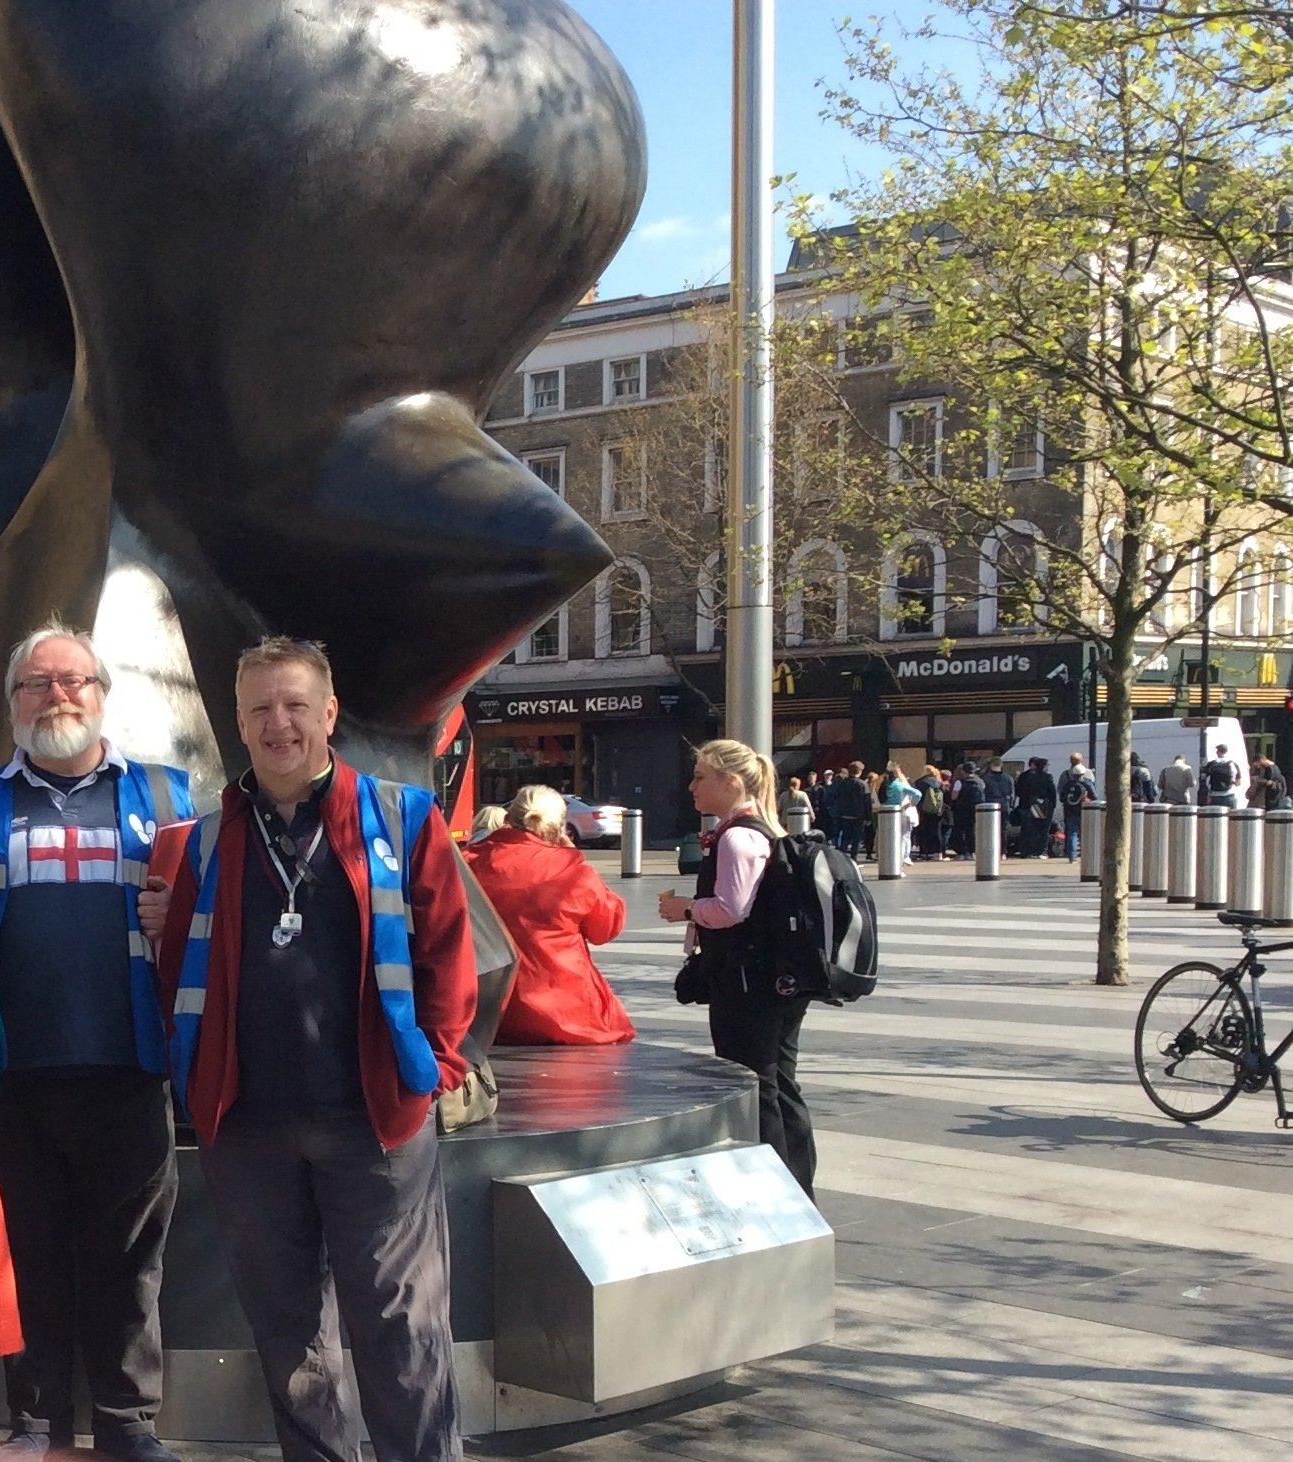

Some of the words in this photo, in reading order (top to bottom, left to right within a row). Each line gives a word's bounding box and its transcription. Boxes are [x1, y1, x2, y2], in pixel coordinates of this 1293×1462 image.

[897, 655, 1031, 677] McDonald's
[507, 700, 579, 716] CRYSTAL
[585, 695, 643, 712] KEBAB
